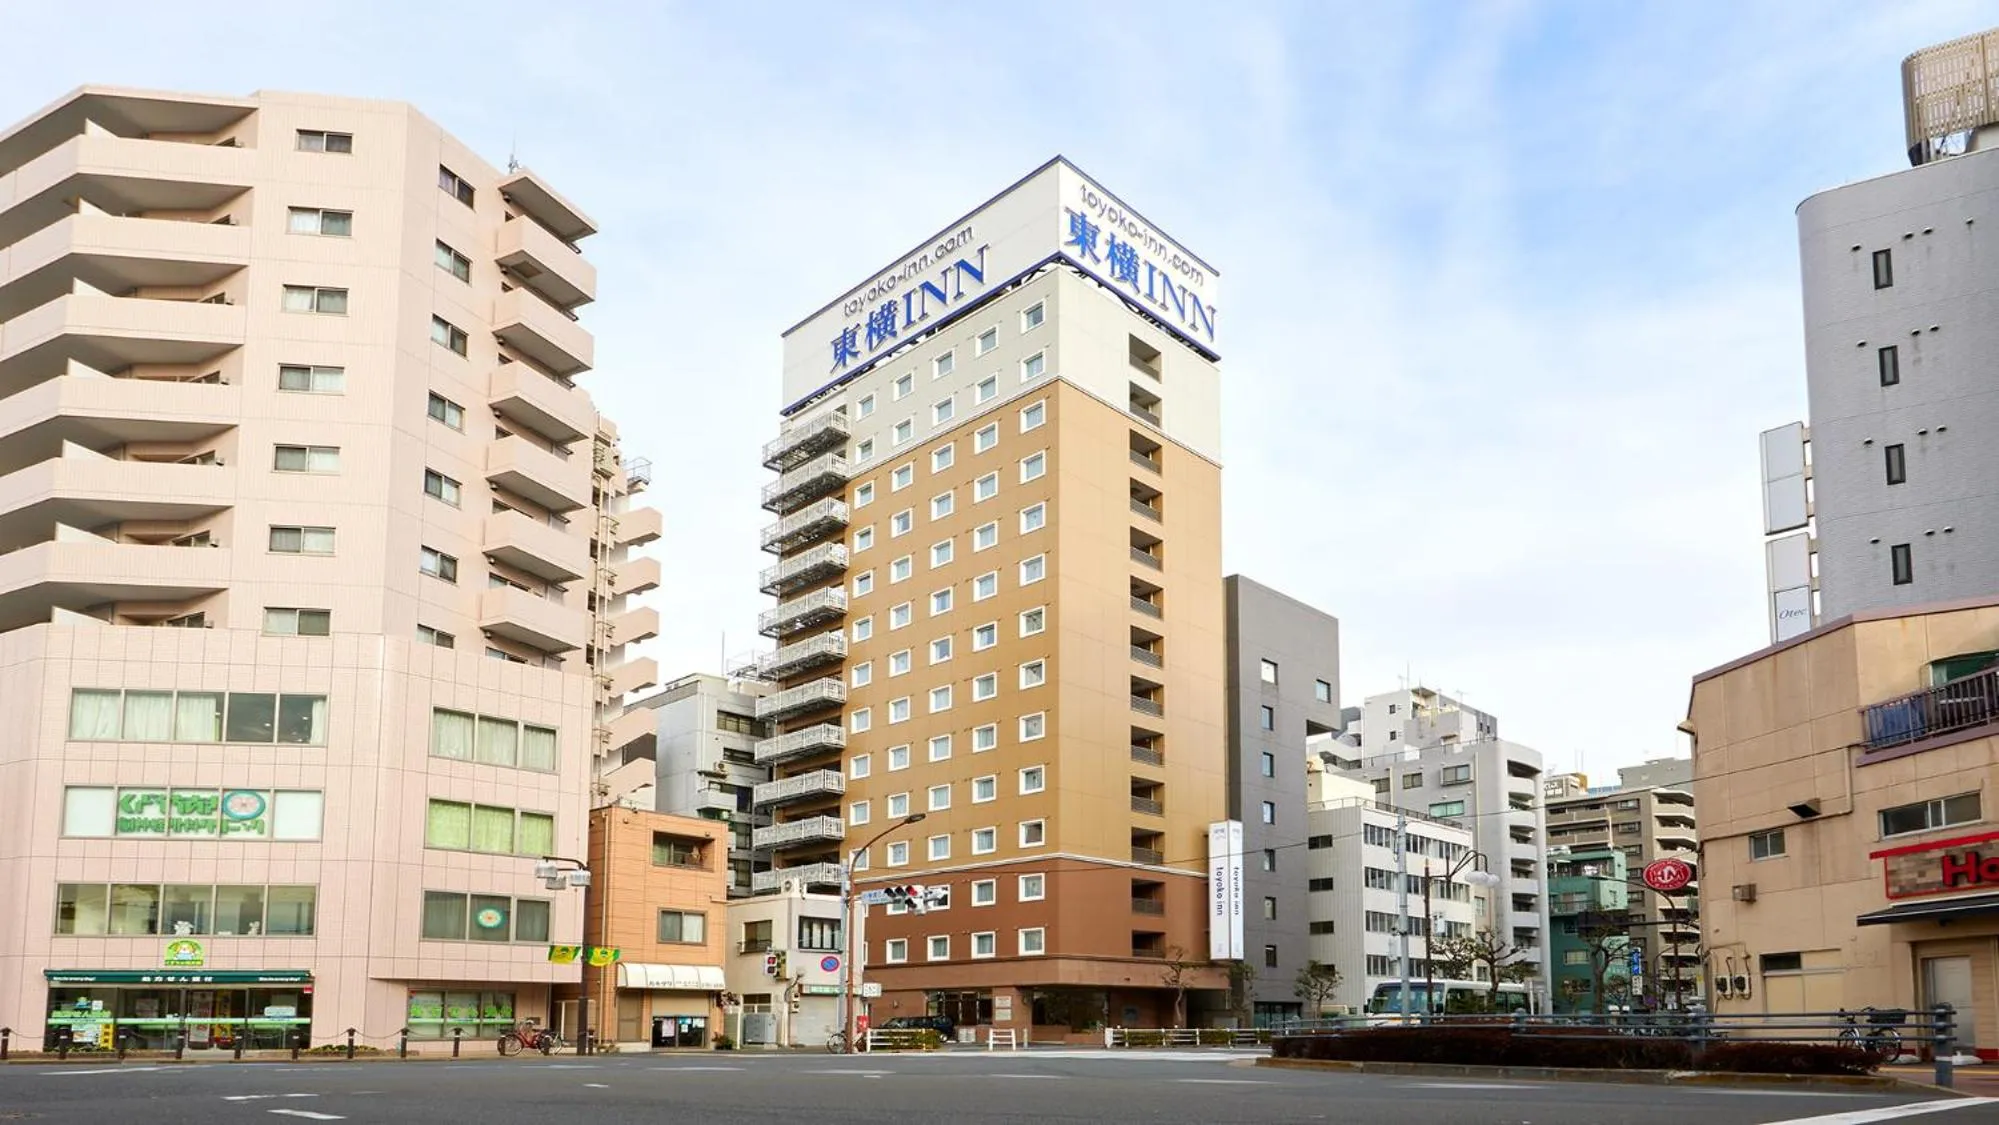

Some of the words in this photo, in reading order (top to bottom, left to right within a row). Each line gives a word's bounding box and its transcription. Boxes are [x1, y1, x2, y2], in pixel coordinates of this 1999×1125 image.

[843, 226, 974, 317] toyoko-inn.com
[1064, 206, 1217, 342] 東横INN
[1080, 184, 1204, 286] toyoko-inn.com
[830, 243, 990, 374] 東横INN
